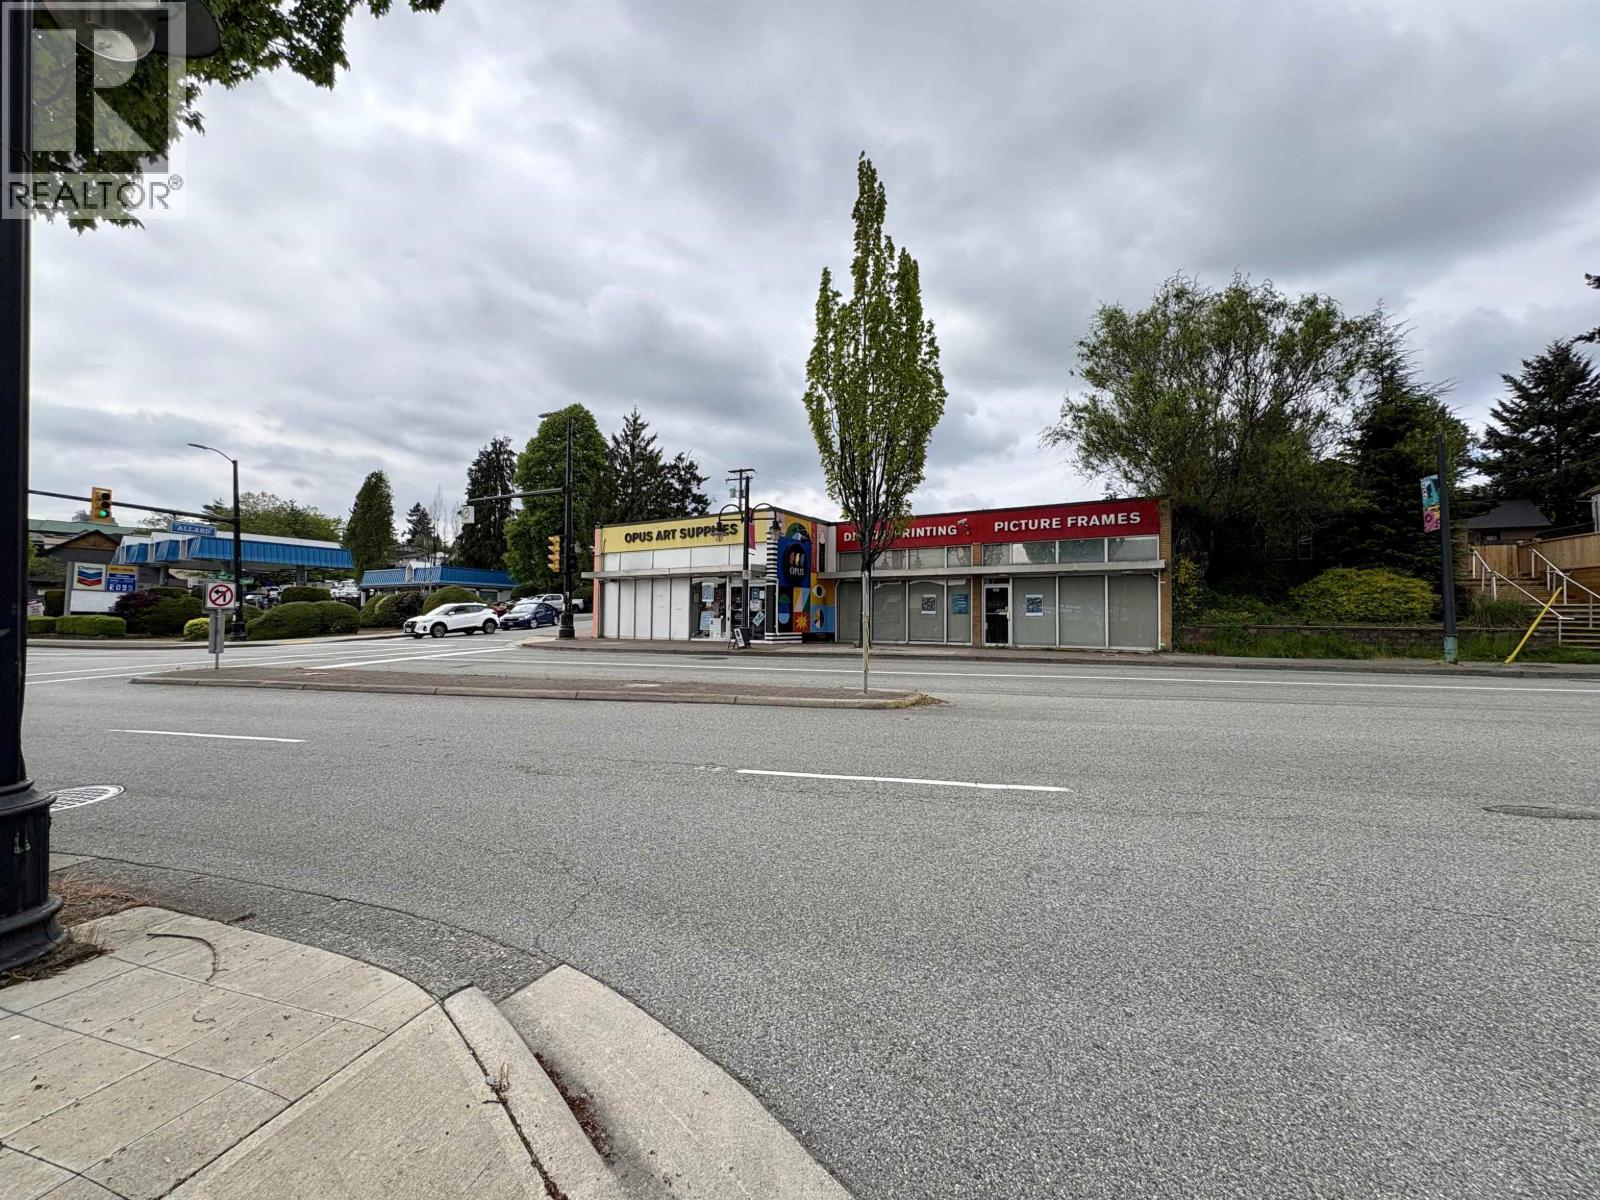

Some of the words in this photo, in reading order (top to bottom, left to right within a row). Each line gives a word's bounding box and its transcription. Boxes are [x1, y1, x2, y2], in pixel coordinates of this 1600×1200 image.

[994, 517, 1061, 532] PICTURE
[1067, 512, 1141, 528] FRAMES
[624, 530, 653, 544] OPUS
[655, 528, 677, 541] ART
[679, 523, 739, 539] SUPPLES
